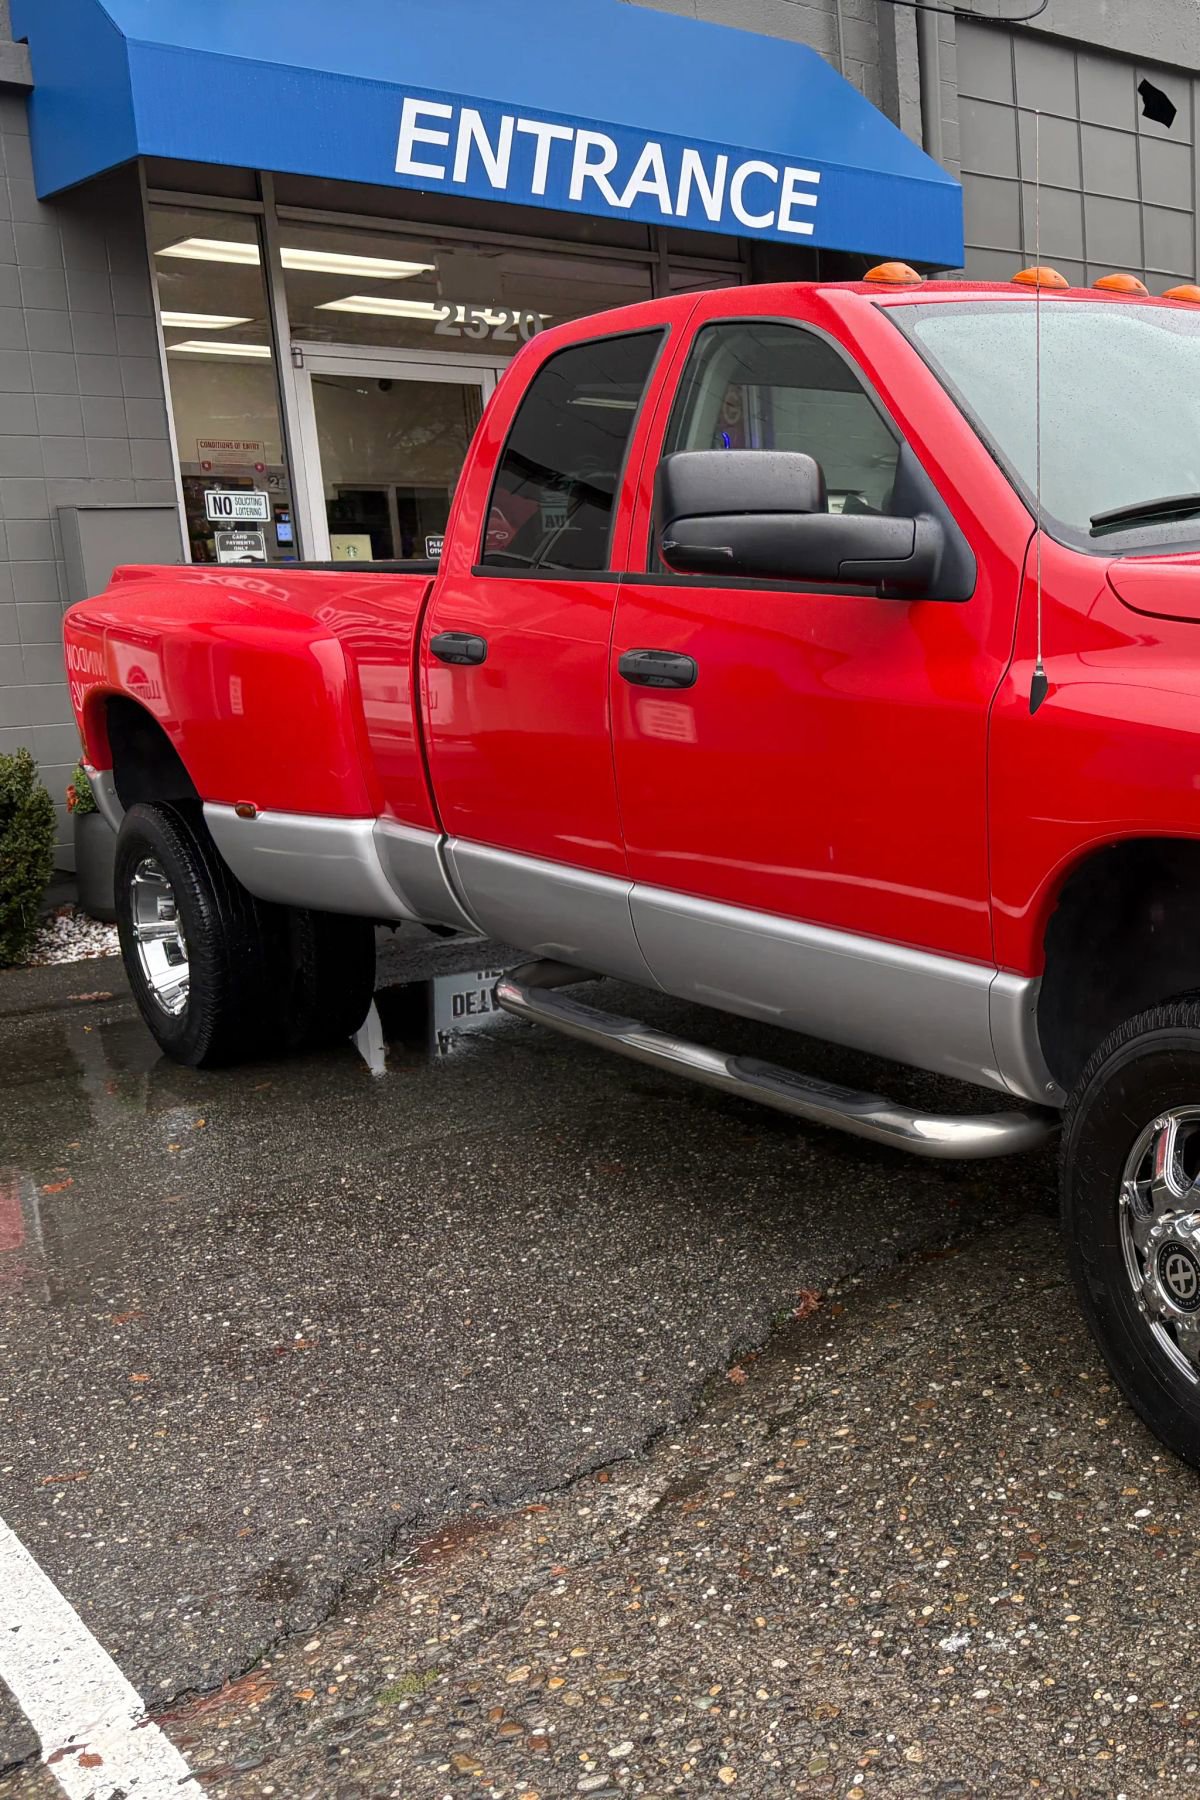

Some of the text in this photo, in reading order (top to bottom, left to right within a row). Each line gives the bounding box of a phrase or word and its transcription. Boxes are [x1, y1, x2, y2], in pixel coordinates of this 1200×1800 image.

[395, 97, 821, 236] ENTRANCE
[434, 300, 543, 342] 2520
[213, 496, 232, 515] NO
[235, 497, 262, 506] SOLICITING
[235, 507, 262, 516] LOITERING
